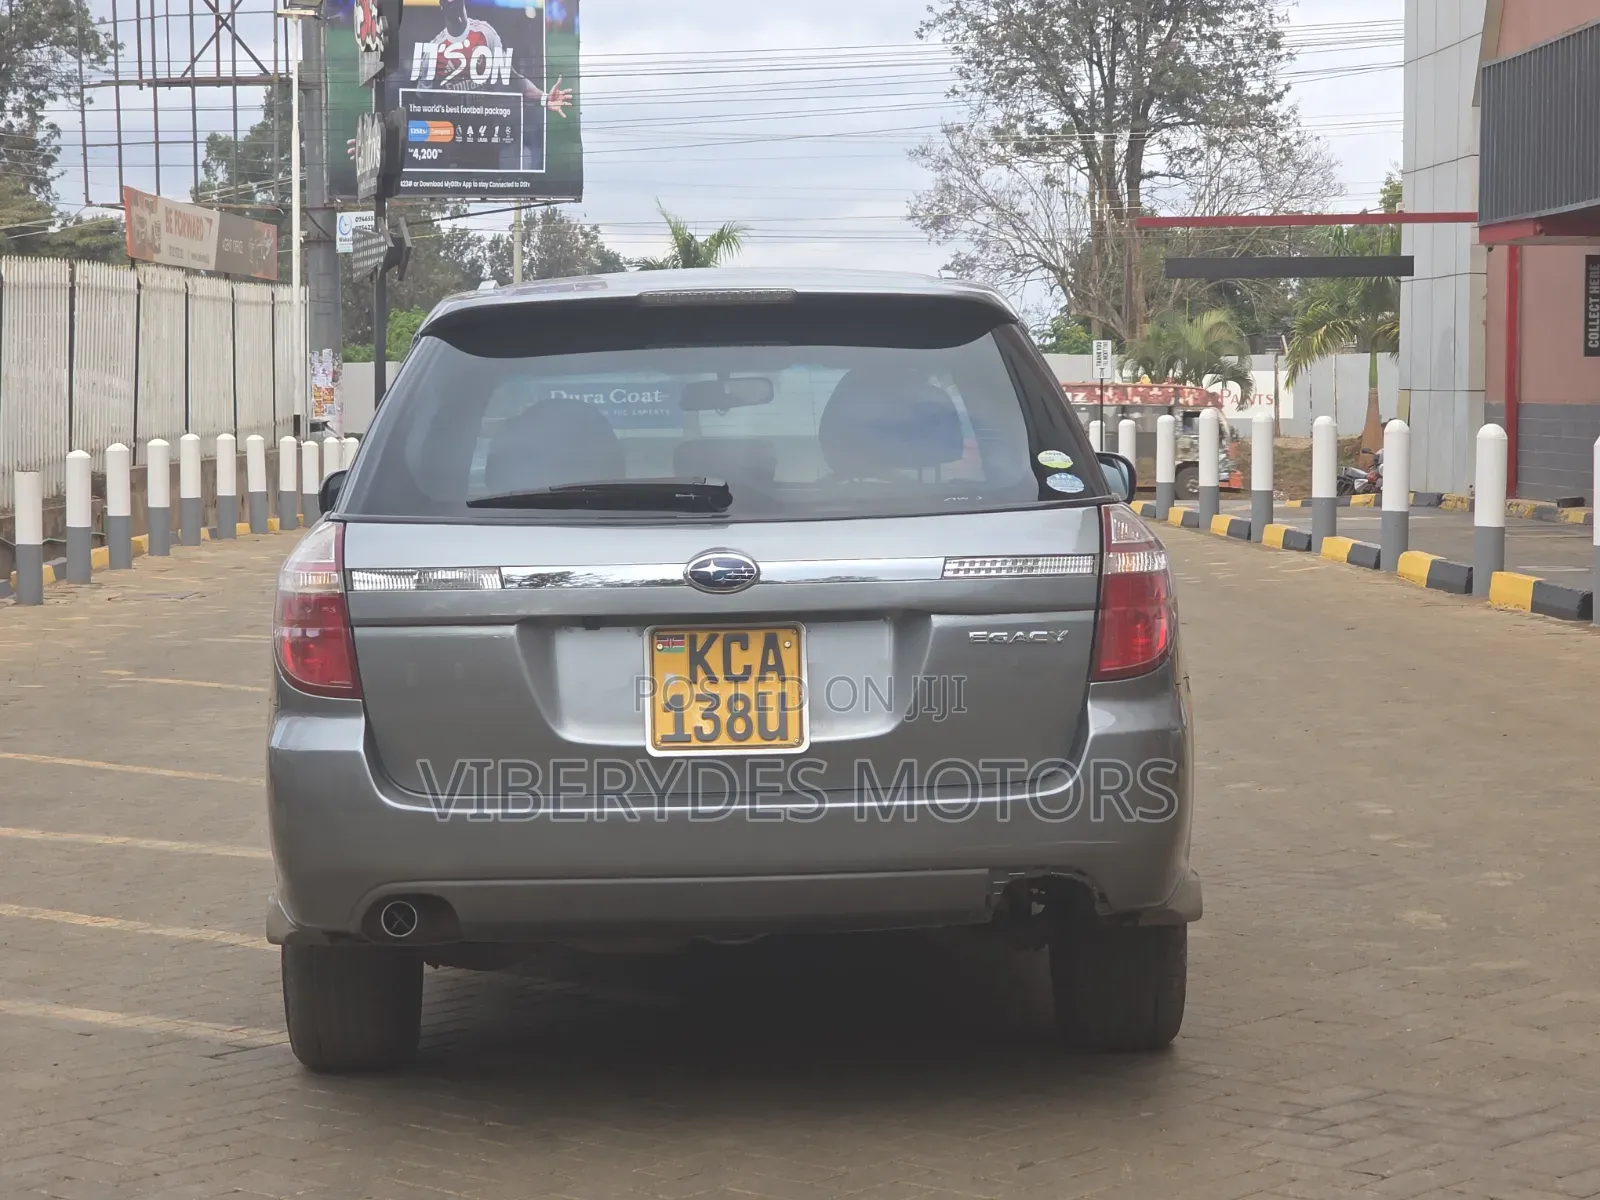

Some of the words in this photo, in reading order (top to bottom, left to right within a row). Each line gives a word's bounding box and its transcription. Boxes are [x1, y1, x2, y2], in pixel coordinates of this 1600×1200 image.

[410, 40, 470, 86] IT'S
[470, 45, 514, 85] ON
[409, 103, 421, 112] The
[422, 103, 445, 113] world's
[446, 104, 460, 114] best
[460, 104, 483, 115] football
[484, 107, 511, 117] package
[420, 180, 443, 188] Download
[463, 180, 472, 189] App
[478, 180, 489, 190] stay
[489, 180, 514, 189] Connected
[164, 206, 173, 234] BE
[174, 209, 204, 242] FORWARD
[1588, 297, 1600, 348] COLLECT
[609, 388, 662, 403] Coat
[689, 633, 786, 684] KCA
[661, 692, 788, 743] 138U
